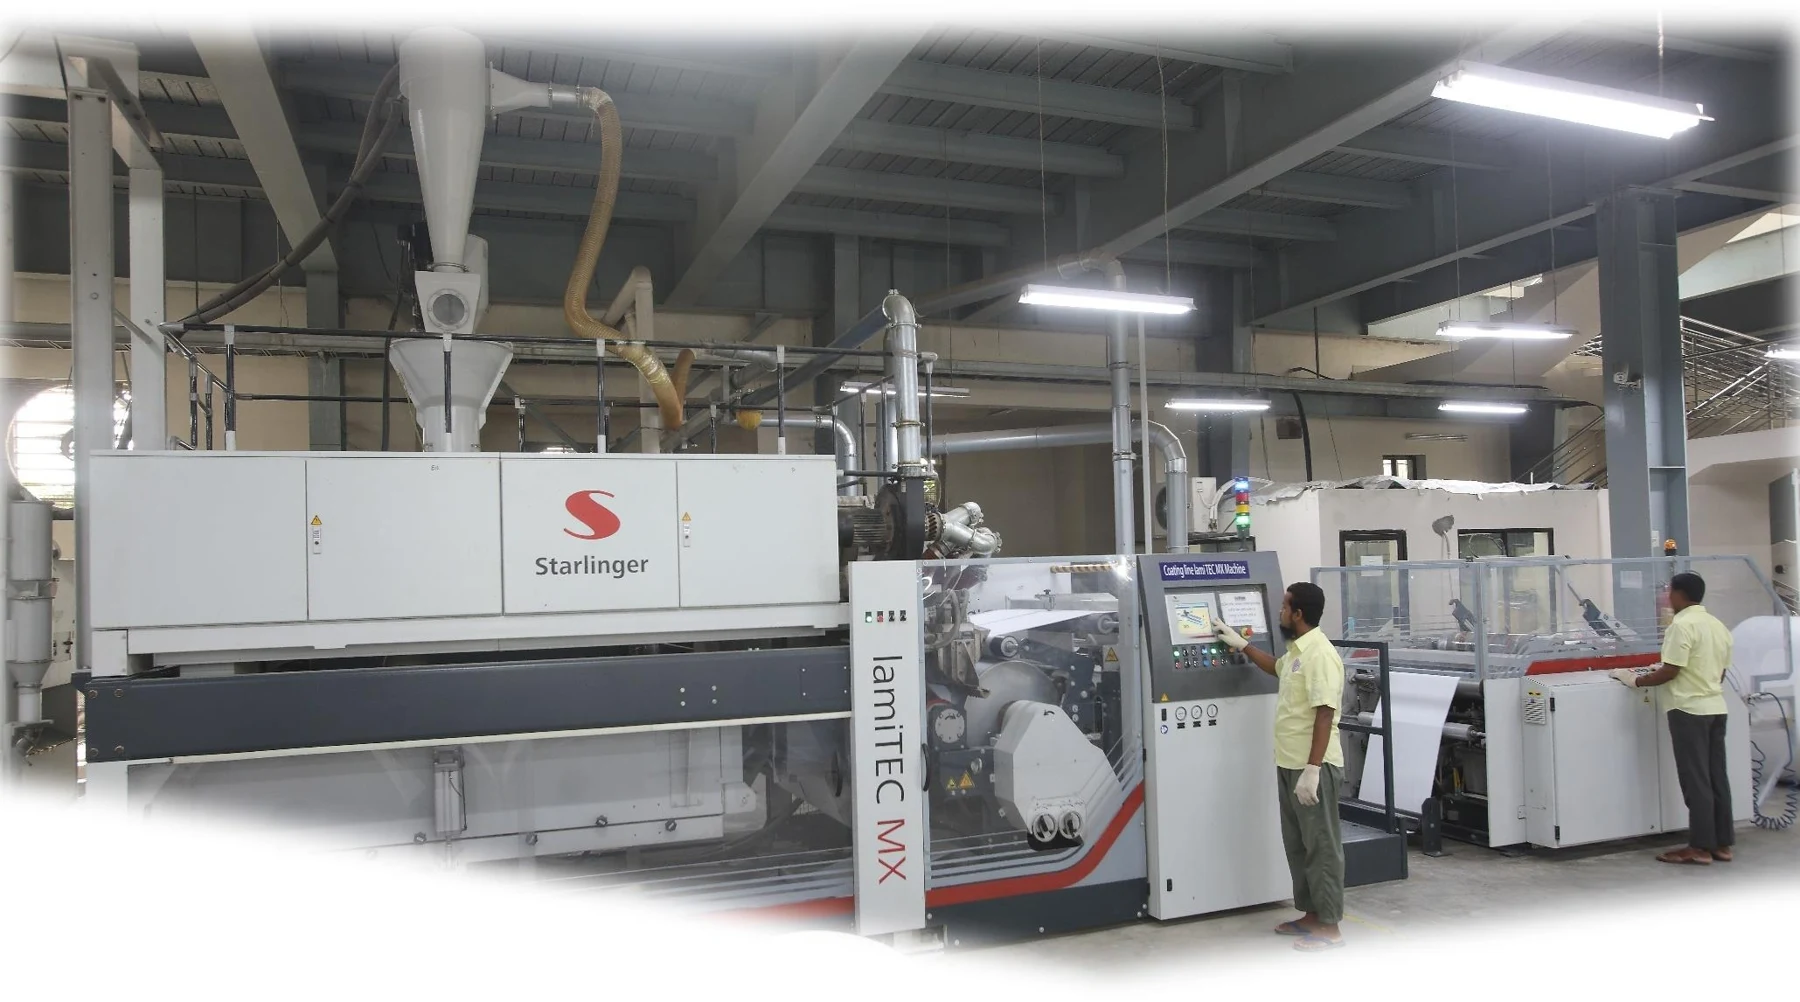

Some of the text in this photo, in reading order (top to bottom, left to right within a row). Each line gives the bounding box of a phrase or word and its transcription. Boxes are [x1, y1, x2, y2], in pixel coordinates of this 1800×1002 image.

[535, 555, 649, 579] Starlinger
[1163, 565, 1185, 579] Coating
[1184, 564, 1194, 575] line
[1215, 563, 1225, 574] MX
[1224, 563, 1246, 574] Machine
[872, 655, 907, 885] lamiTEC MX
